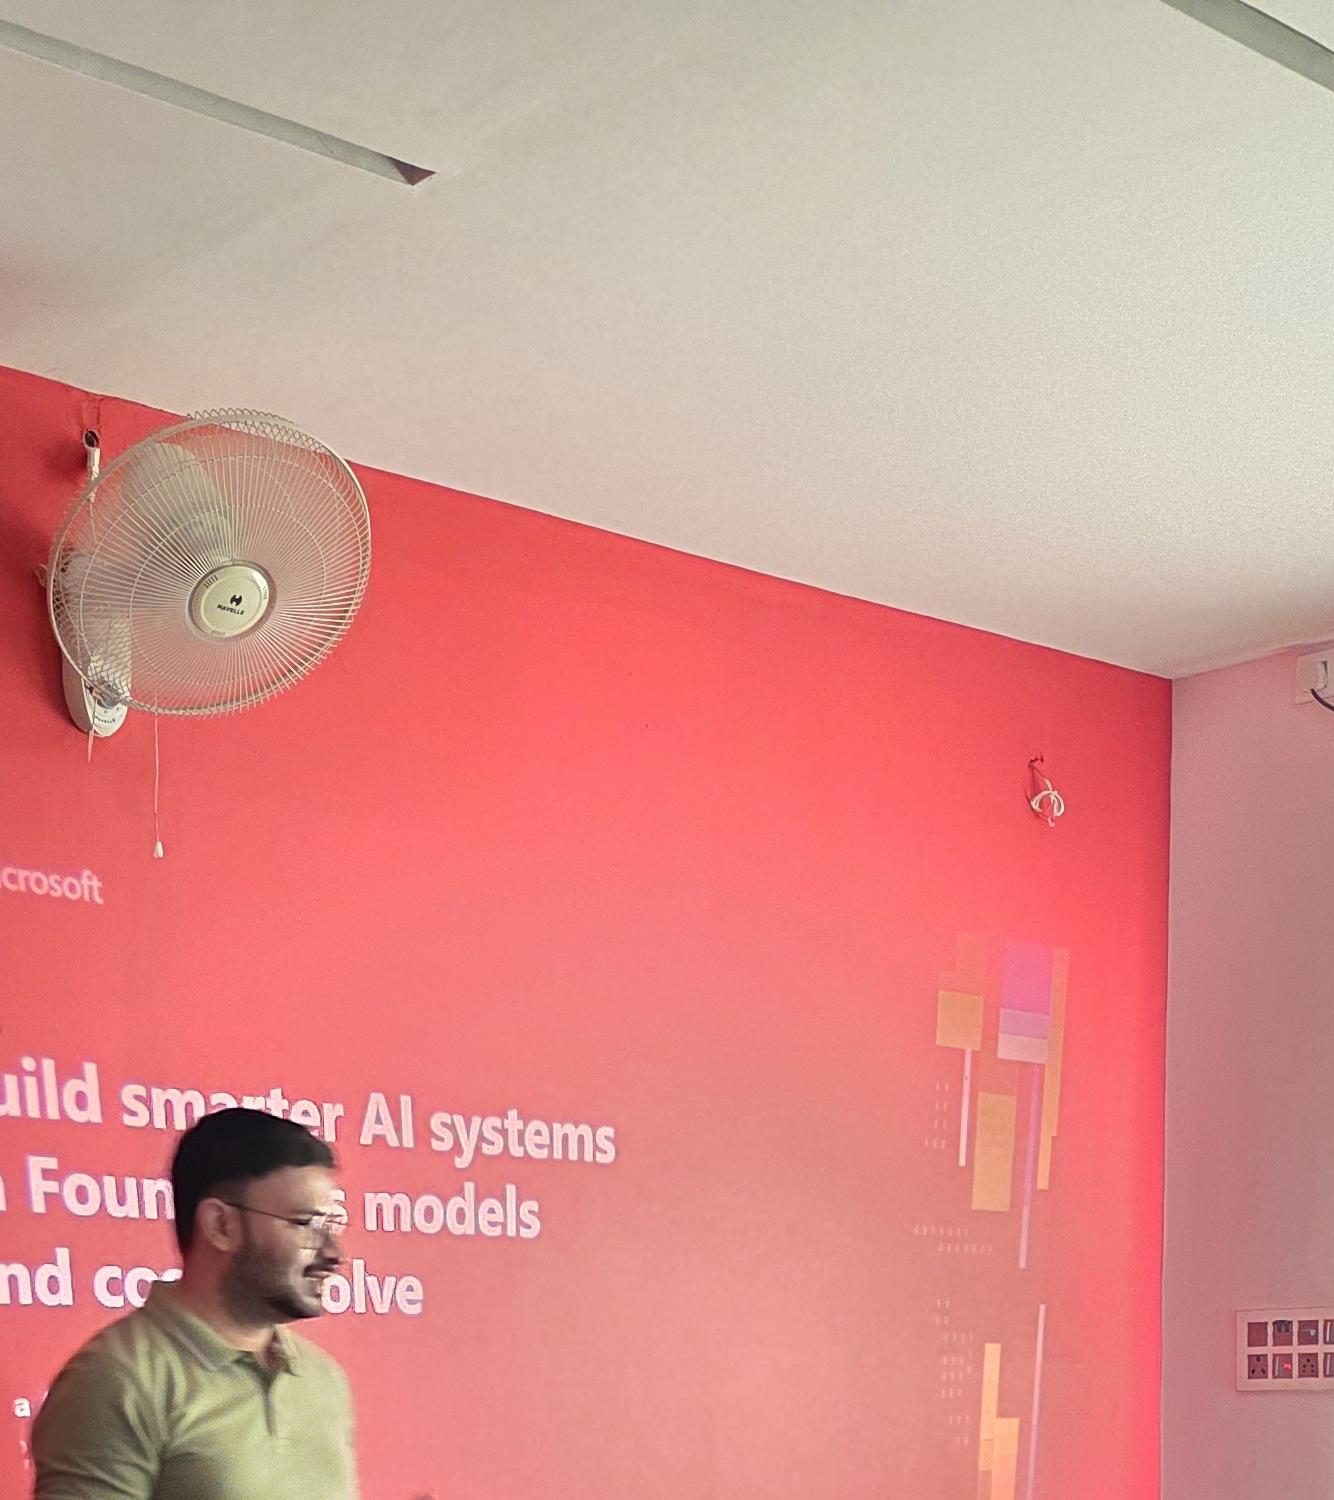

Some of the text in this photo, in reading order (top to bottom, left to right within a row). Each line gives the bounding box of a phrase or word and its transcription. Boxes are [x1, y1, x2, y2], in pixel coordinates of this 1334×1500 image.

[120, 1083, 345, 1143] smter
[359, 1091, 415, 1148] AI
[429, 1108, 616, 1169] systems
[27, 1154, 176, 1221] Foun
[363, 1181, 542, 1239] models
[320, 1258, 425, 1314] olve
